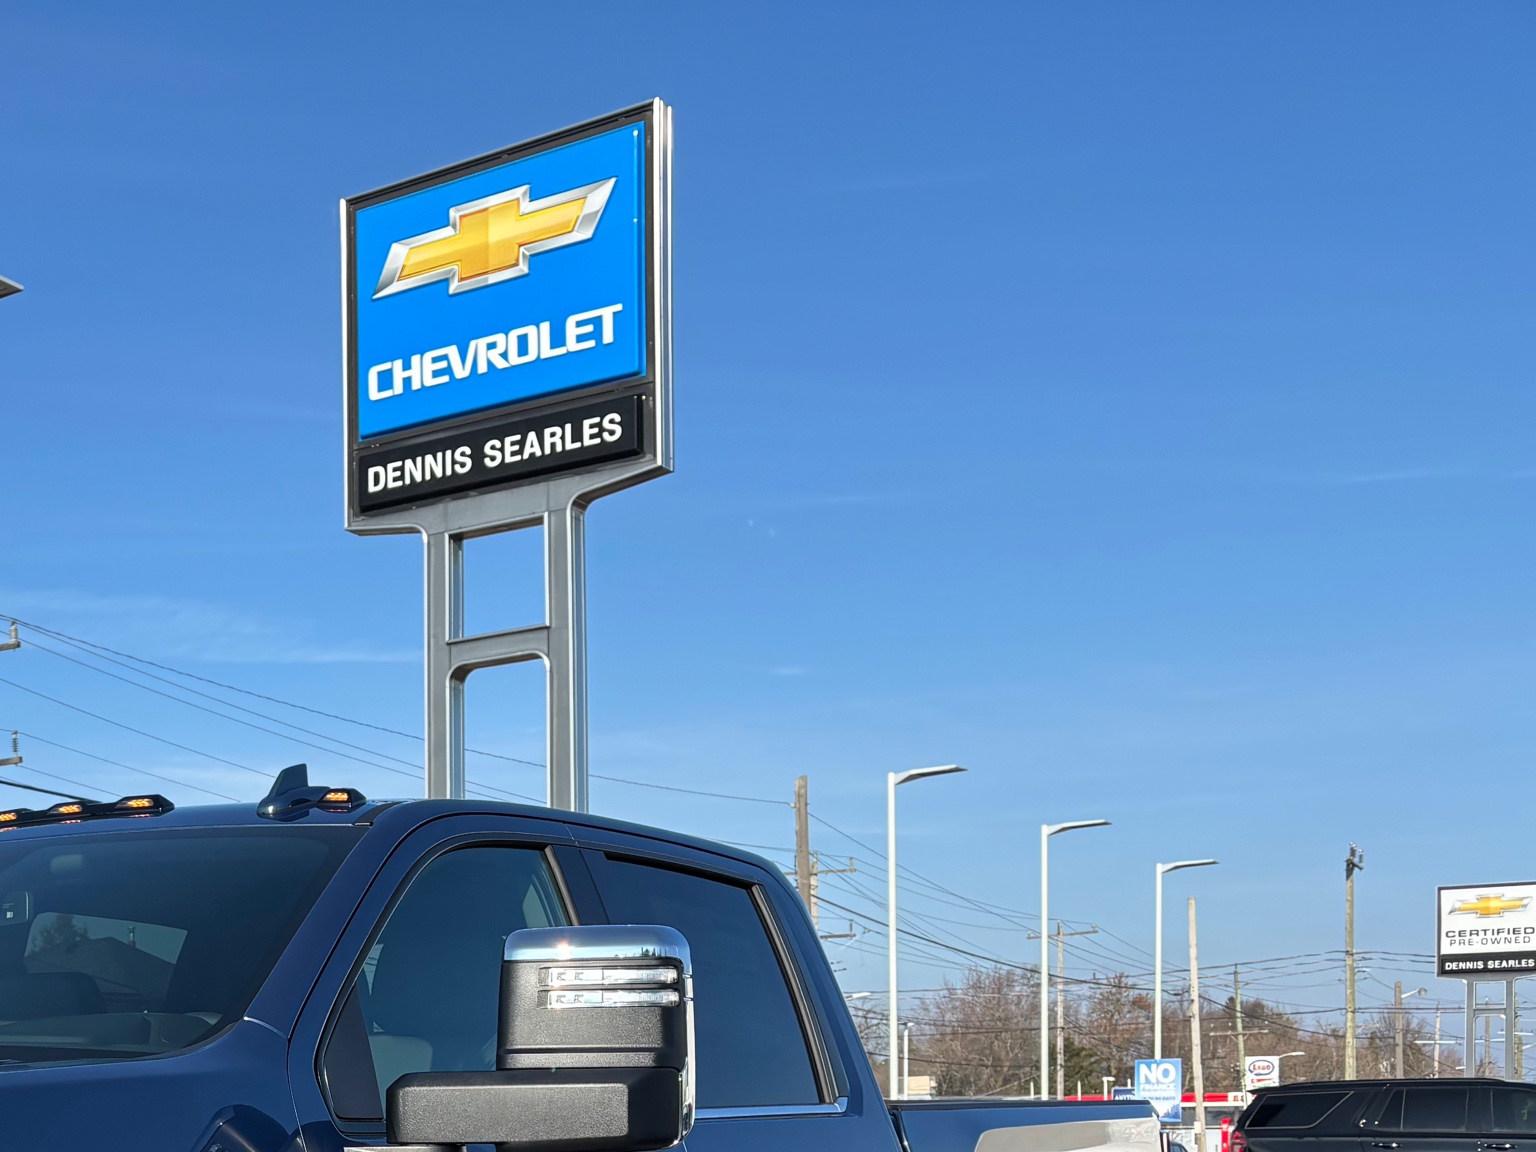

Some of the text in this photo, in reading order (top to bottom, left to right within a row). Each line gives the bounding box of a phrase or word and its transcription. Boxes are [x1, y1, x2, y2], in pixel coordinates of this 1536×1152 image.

[368, 302, 624, 401] CHEVROLET
[367, 412, 624, 494] DENNIS SEARLES
[1445, 926, 1536, 938] CERTIFIED
[1449, 936, 1532, 947] PRE-OWNED
[1445, 958, 1536, 971] DENNIS SEARLES
[1140, 1063, 1176, 1083] NO
